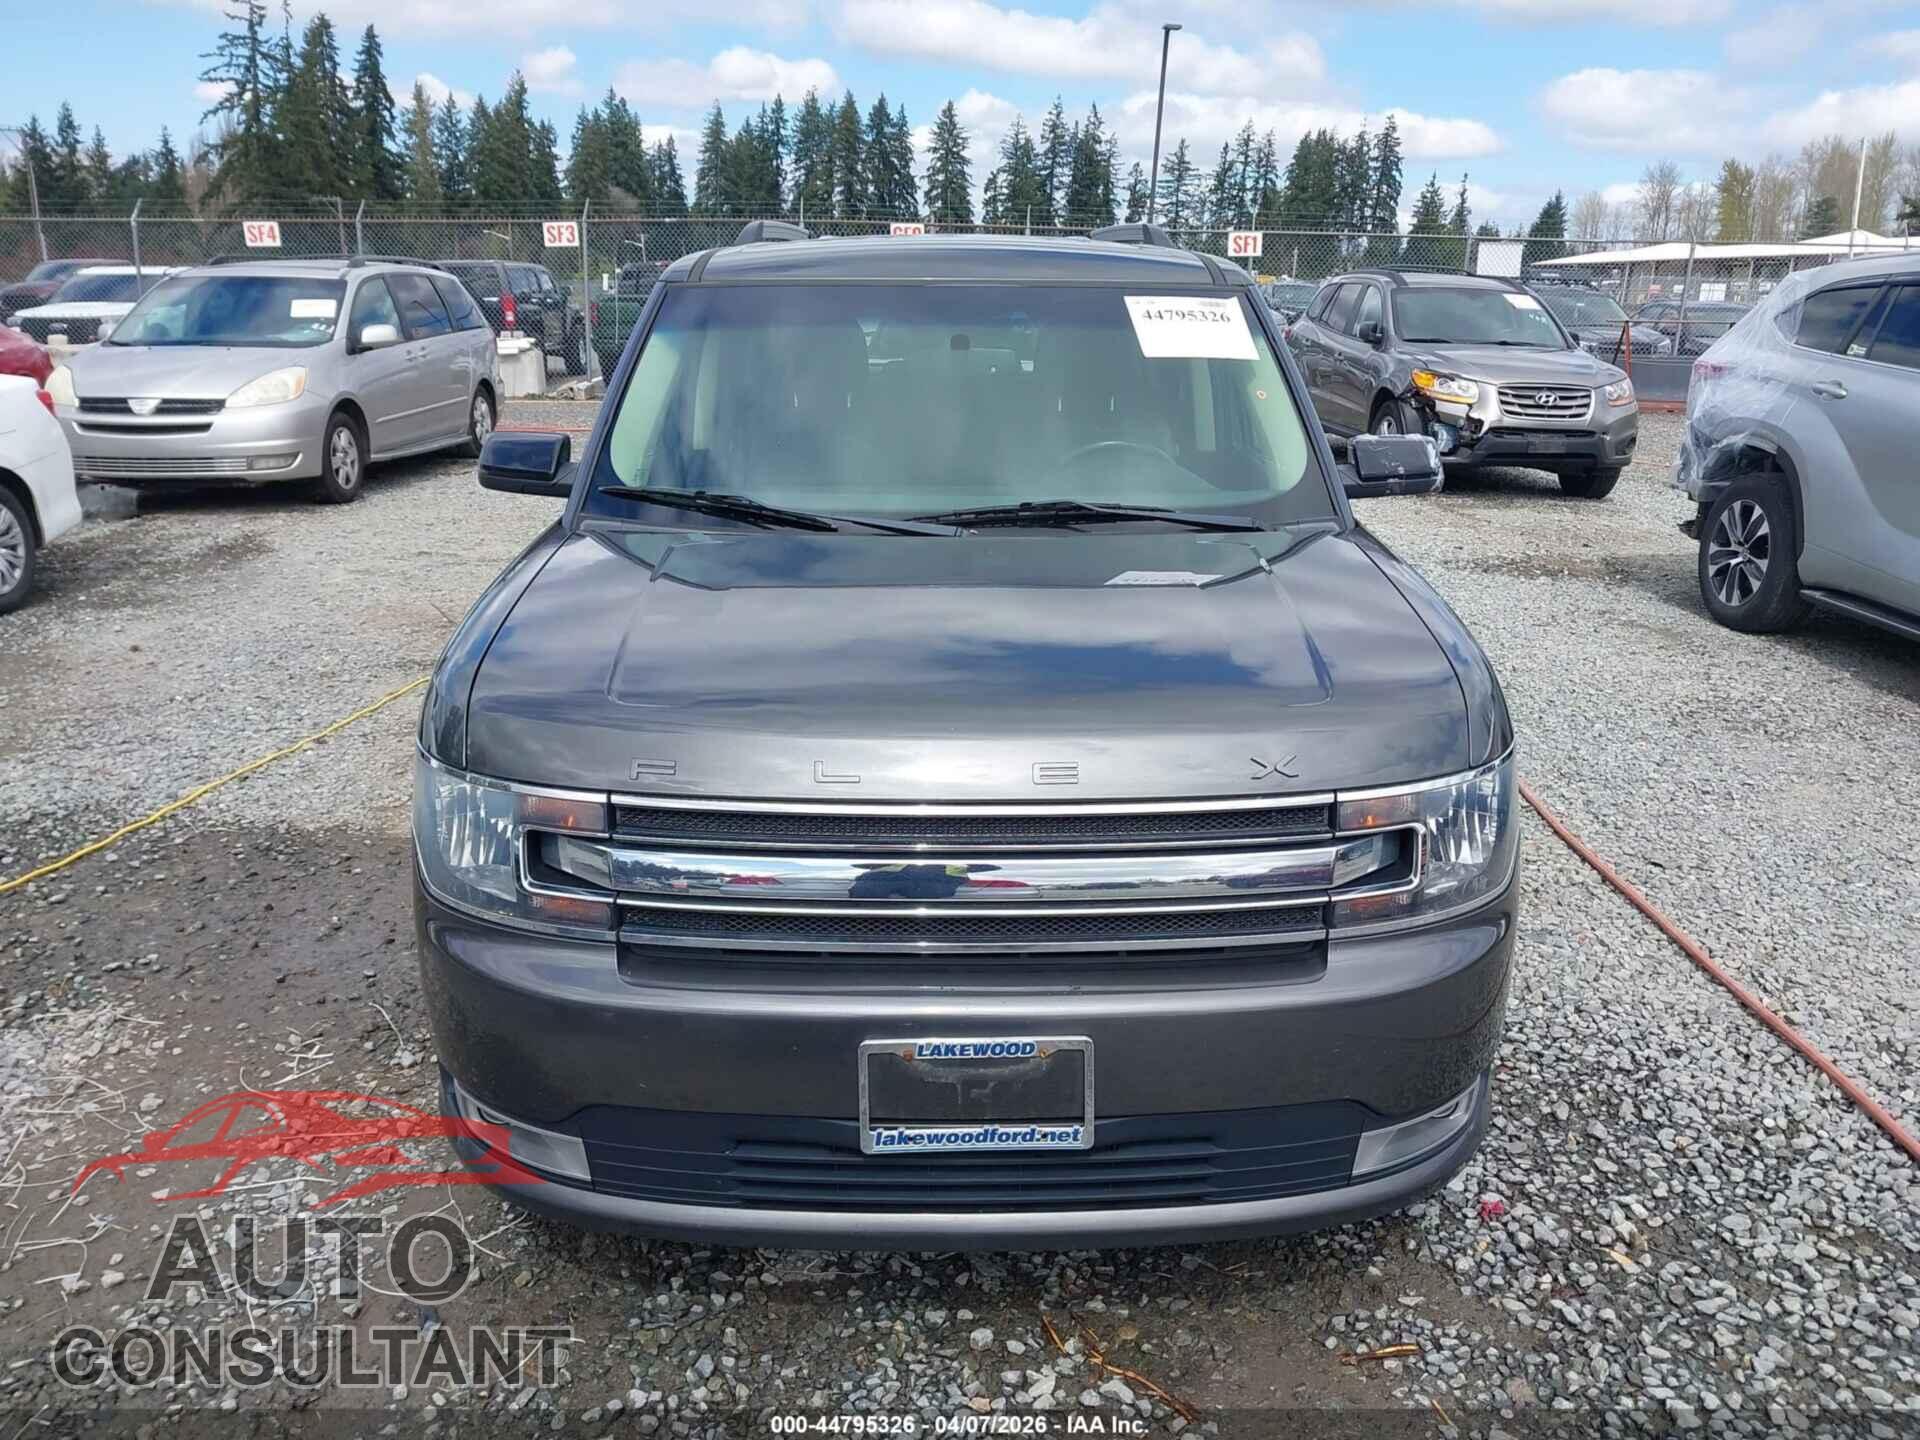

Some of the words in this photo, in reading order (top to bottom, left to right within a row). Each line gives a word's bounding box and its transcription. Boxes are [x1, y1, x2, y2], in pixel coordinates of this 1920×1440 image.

[247, 224, 278, 243] SF4
[546, 224, 576, 244] SF3
[1233, 235, 1257, 254] SF1
[1142, 309, 1231, 323] 44795326
[629, 757, 1299, 784] FLEX
[917, 1041, 1036, 1058] LAKEWOOD
[875, 1128, 1083, 1147] lakewoodford.net
